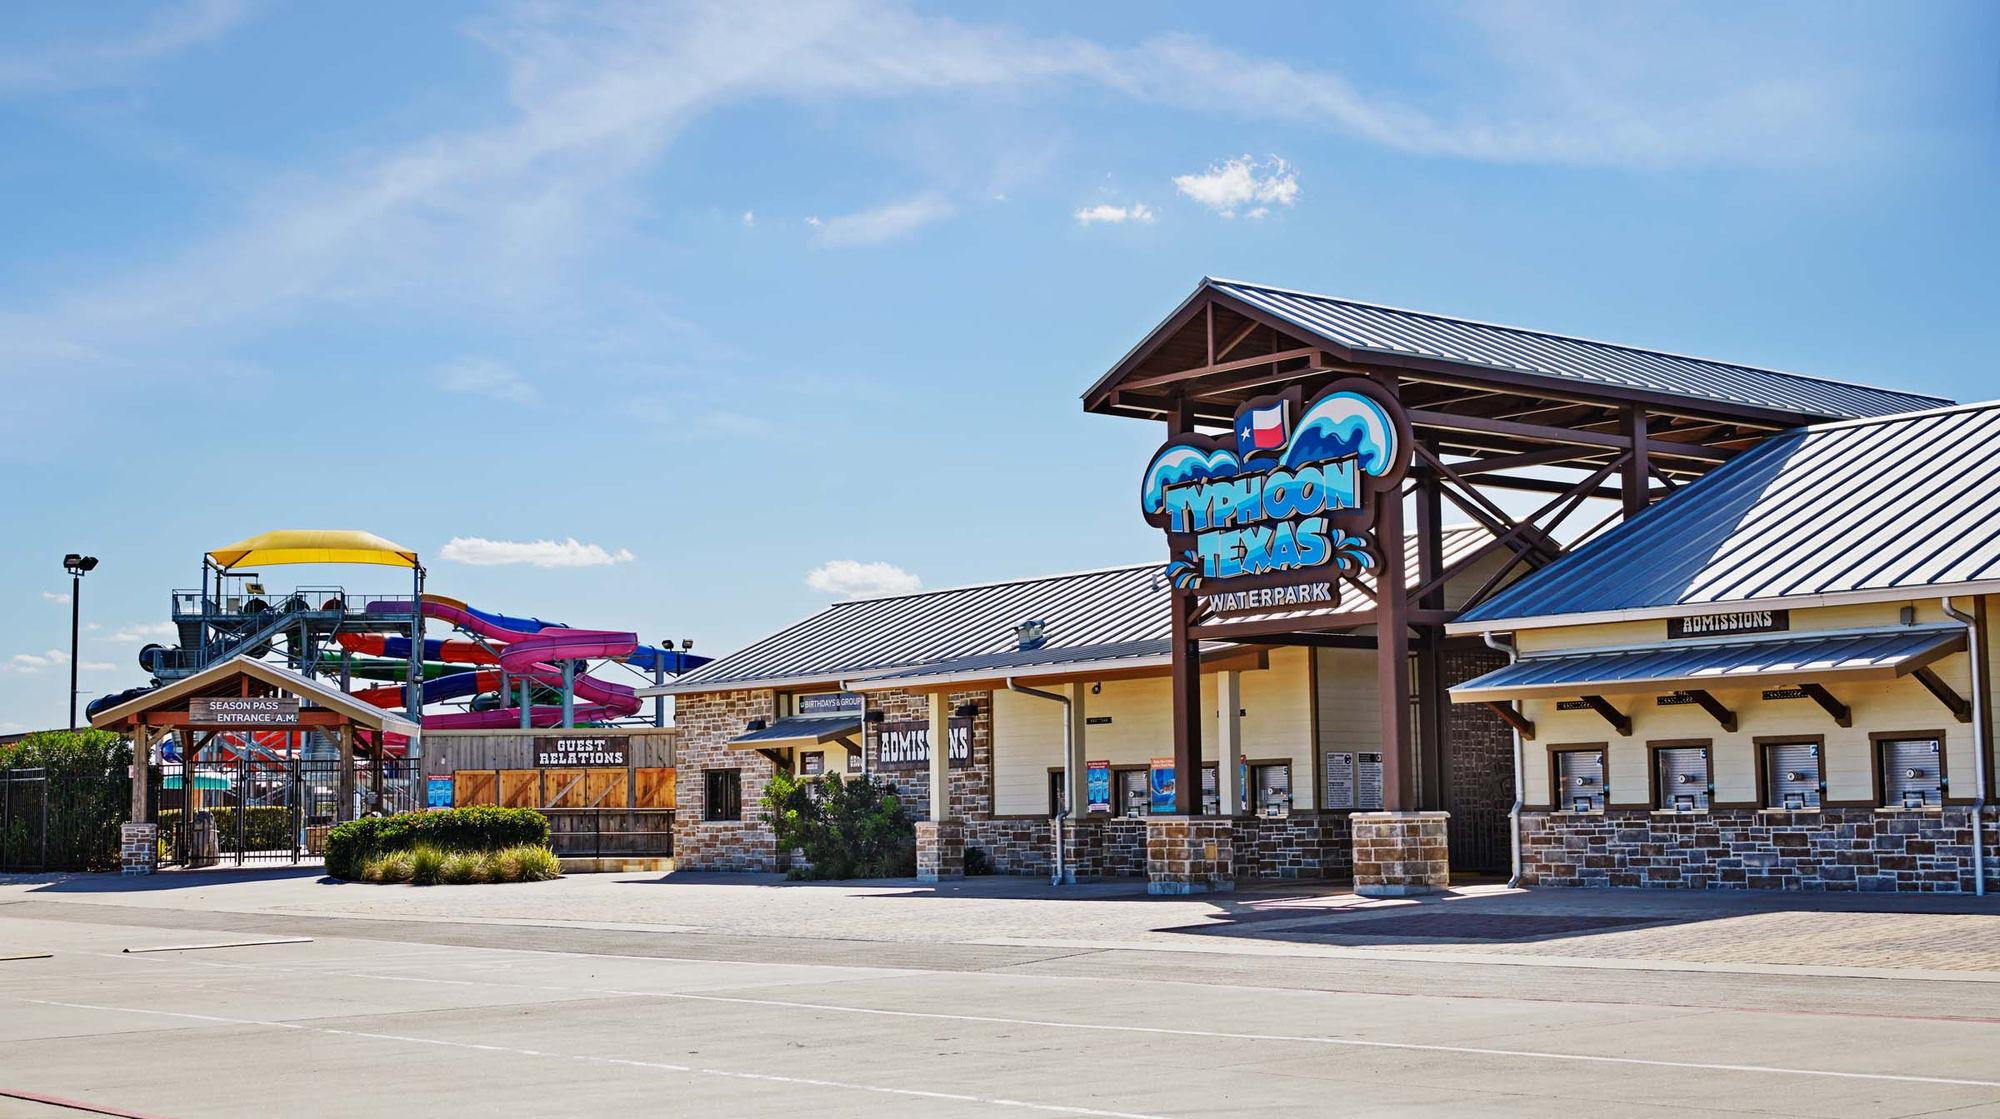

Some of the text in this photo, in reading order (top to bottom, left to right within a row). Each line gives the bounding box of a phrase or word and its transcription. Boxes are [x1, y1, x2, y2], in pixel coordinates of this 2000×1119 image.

[1166, 458, 1356, 533] TYPHOON
[1198, 517, 1327, 578] TEXAS
[1209, 582, 1331, 612] WATERPARK
[1682, 611, 1773, 633] ADMISSIONS
[209, 701, 279, 710] SEASON PASS
[805, 699, 835, 708] BIRTHDAYS
[217, 713, 297, 722] ENTRANCE A.M.
[557, 740, 605, 751] GUEST
[881, 727, 968, 762] ADMISNS
[1931, 742, 1939, 753] 1
[1811, 746, 1818, 757] 2
[540, 752, 623, 764] RELATIONS
